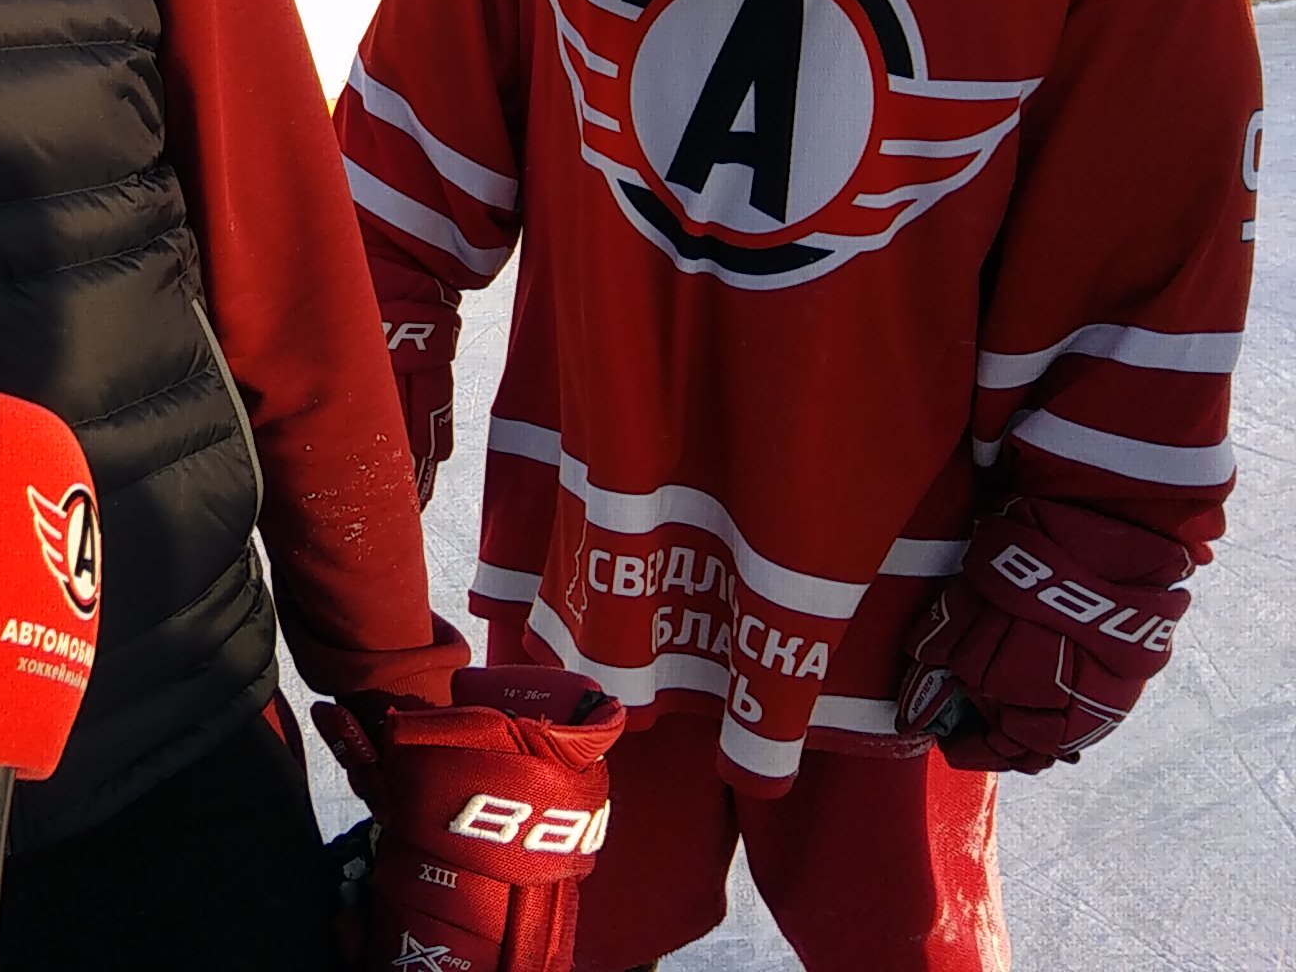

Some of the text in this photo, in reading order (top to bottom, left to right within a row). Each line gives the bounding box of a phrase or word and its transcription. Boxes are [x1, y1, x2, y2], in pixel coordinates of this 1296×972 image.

[989, 544, 1178, 652] BAUE
[0, 618, 96, 668] АВТОМОБИ
[418, 863, 458, 889] XIII
[438, 954, 472, 971] PRO
